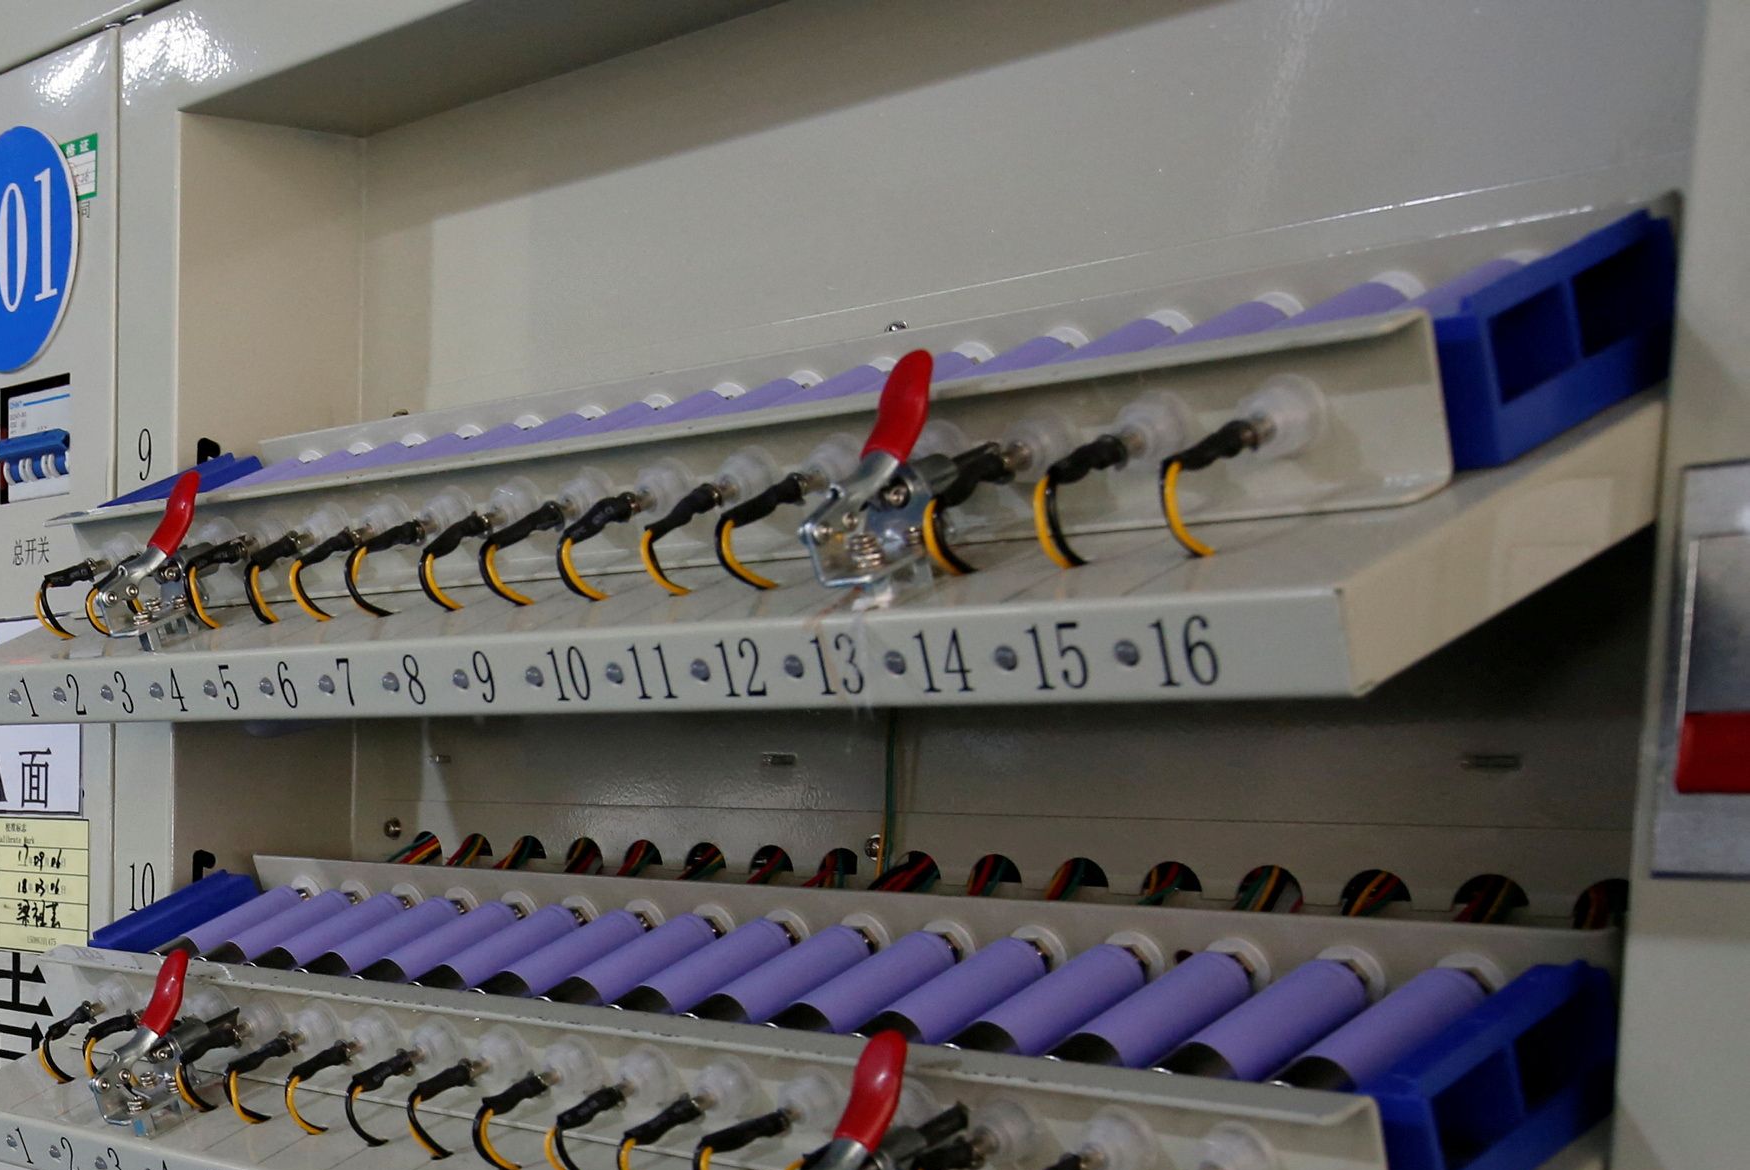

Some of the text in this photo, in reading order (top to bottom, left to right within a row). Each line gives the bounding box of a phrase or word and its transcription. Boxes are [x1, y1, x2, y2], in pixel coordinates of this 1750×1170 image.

[138, 428, 152, 481] 9
[12, 536, 50, 566] 总开关
[19, 614, 1221, 717] 1 2 3 4 5 6 7 8 9 10 11 12 13 14 15 16
[19, 748, 52, 809] 面
[129, 862, 156, 913] 10
[14, 1127, 35, 1165] 1
